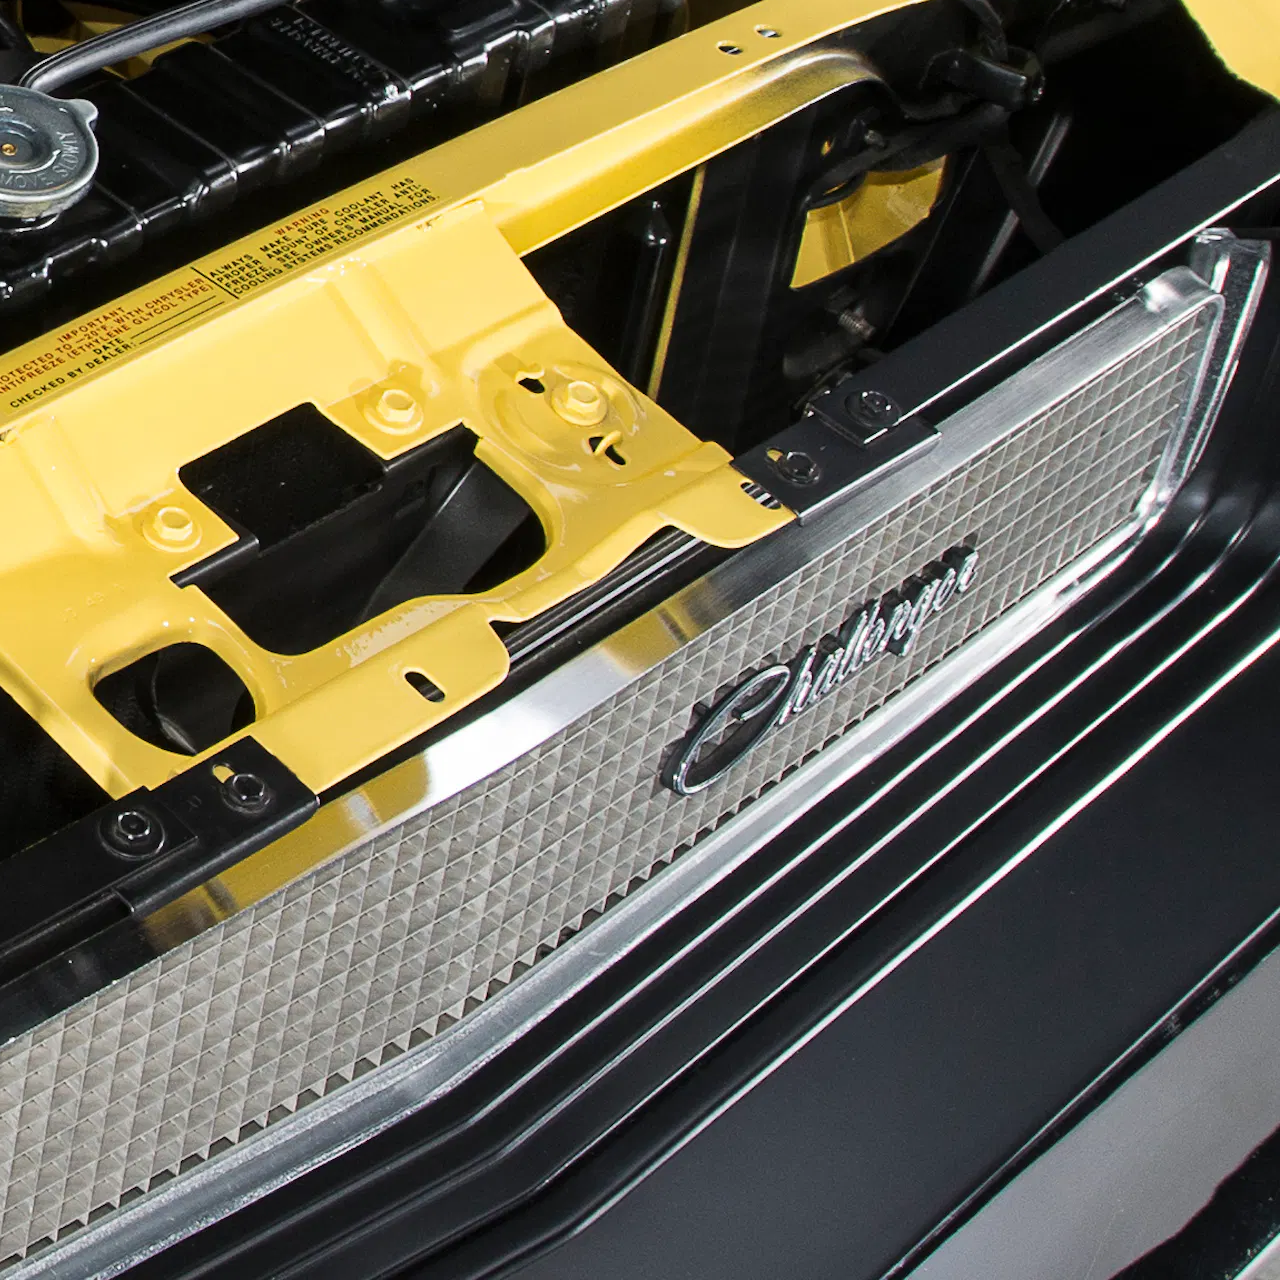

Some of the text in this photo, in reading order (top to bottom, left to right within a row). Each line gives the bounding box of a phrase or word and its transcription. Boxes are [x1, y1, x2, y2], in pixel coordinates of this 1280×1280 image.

[51, 129, 81, 178] SLOWLY
[206, 176, 415, 278] ALWAYS MAKE SURE COOLANT HAS
[214, 182, 422, 283] PROPER AMOUNT OF CHRYSLER ANTI-
[231, 191, 440, 295] COOLING SYSTEMS RECOMMENDATIONS.
[274, 207, 331, 236] WARNING
[275, 249, 301, 263] SEE
[303, 223, 355, 250] OWNER'S
[357, 200, 403, 225] MANUAL
[405, 187, 431, 201] FOR
[55, 342, 74, 353] TO
[112, 307, 145, 324] WITH
[142, 276, 206, 309] CHRYSLER
[55, 306, 127, 343] IMPORTANT
[64, 323, 133, 359] (ETHYLENE
[130, 300, 179, 326] GLYCOL
[176, 282, 215, 303] TYPE)
[91, 336, 125, 355] DATE
[7, 340, 138, 408] CHECKED BY DEALER:
[662, 547, 980, 796] Challenger
